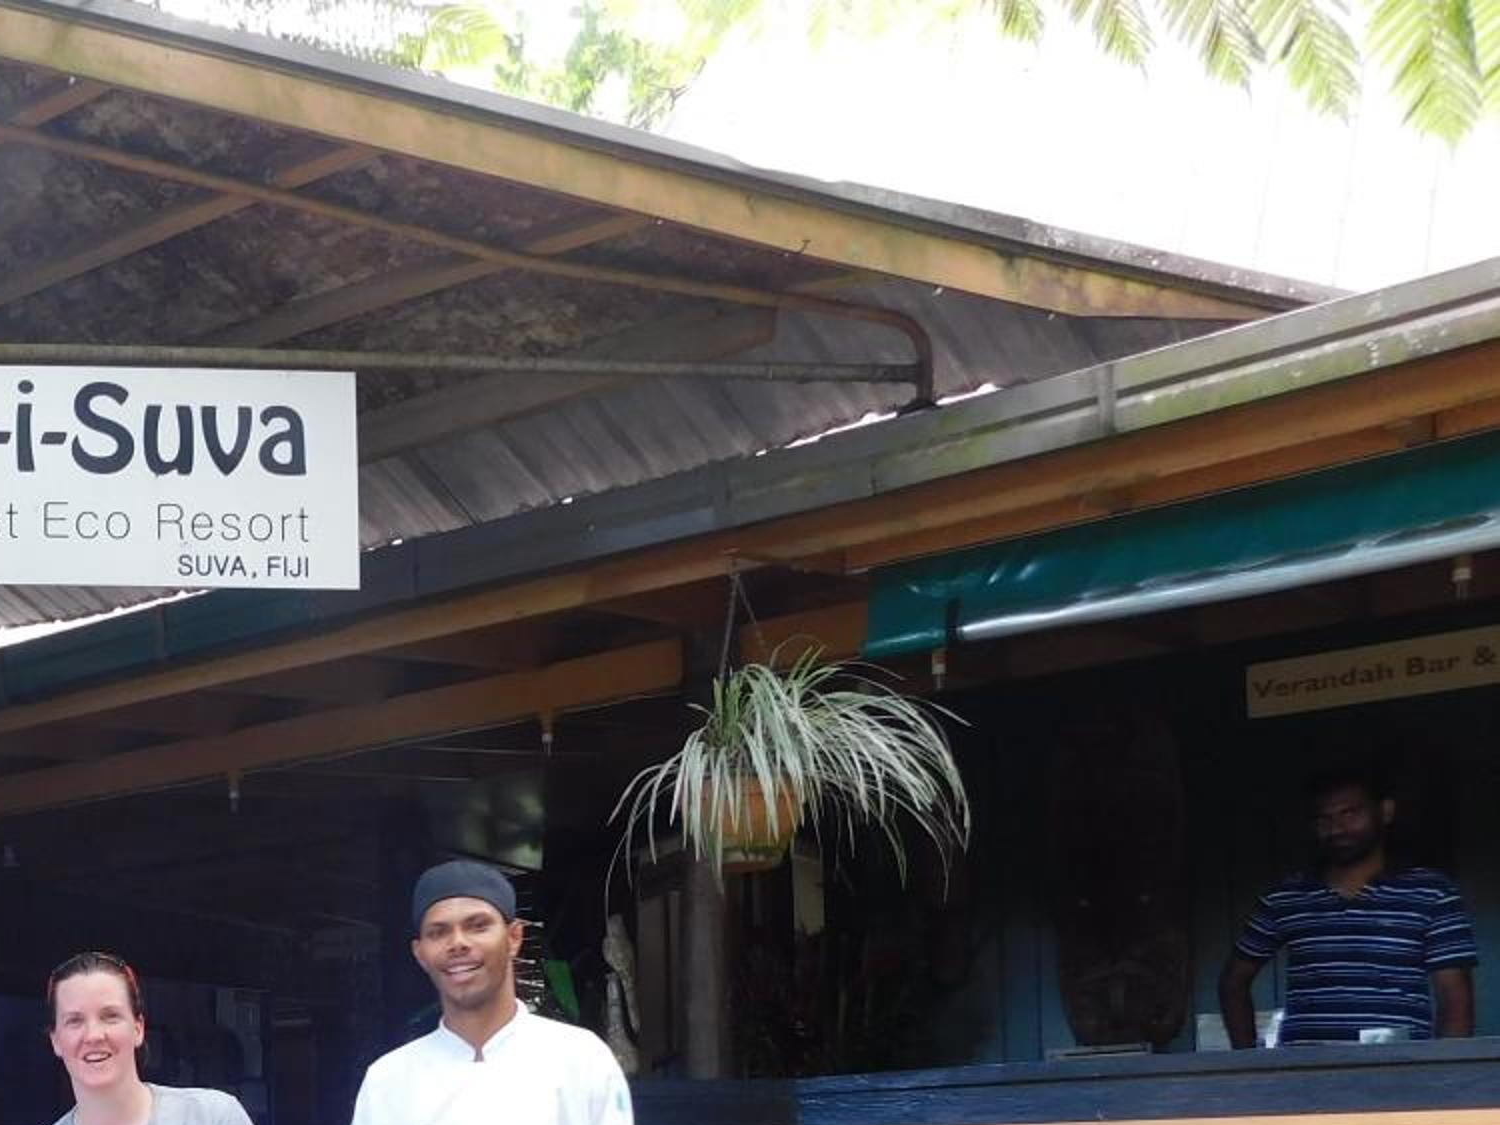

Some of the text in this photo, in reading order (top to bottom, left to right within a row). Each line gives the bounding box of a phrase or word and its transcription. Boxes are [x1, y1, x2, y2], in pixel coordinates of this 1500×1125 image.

[43, 501, 131, 541] Eco
[157, 503, 310, 543] Resort
[177, 554, 309, 579] SUVA, FIJI
[1252, 644, 1497, 698] Verandah Bar &
